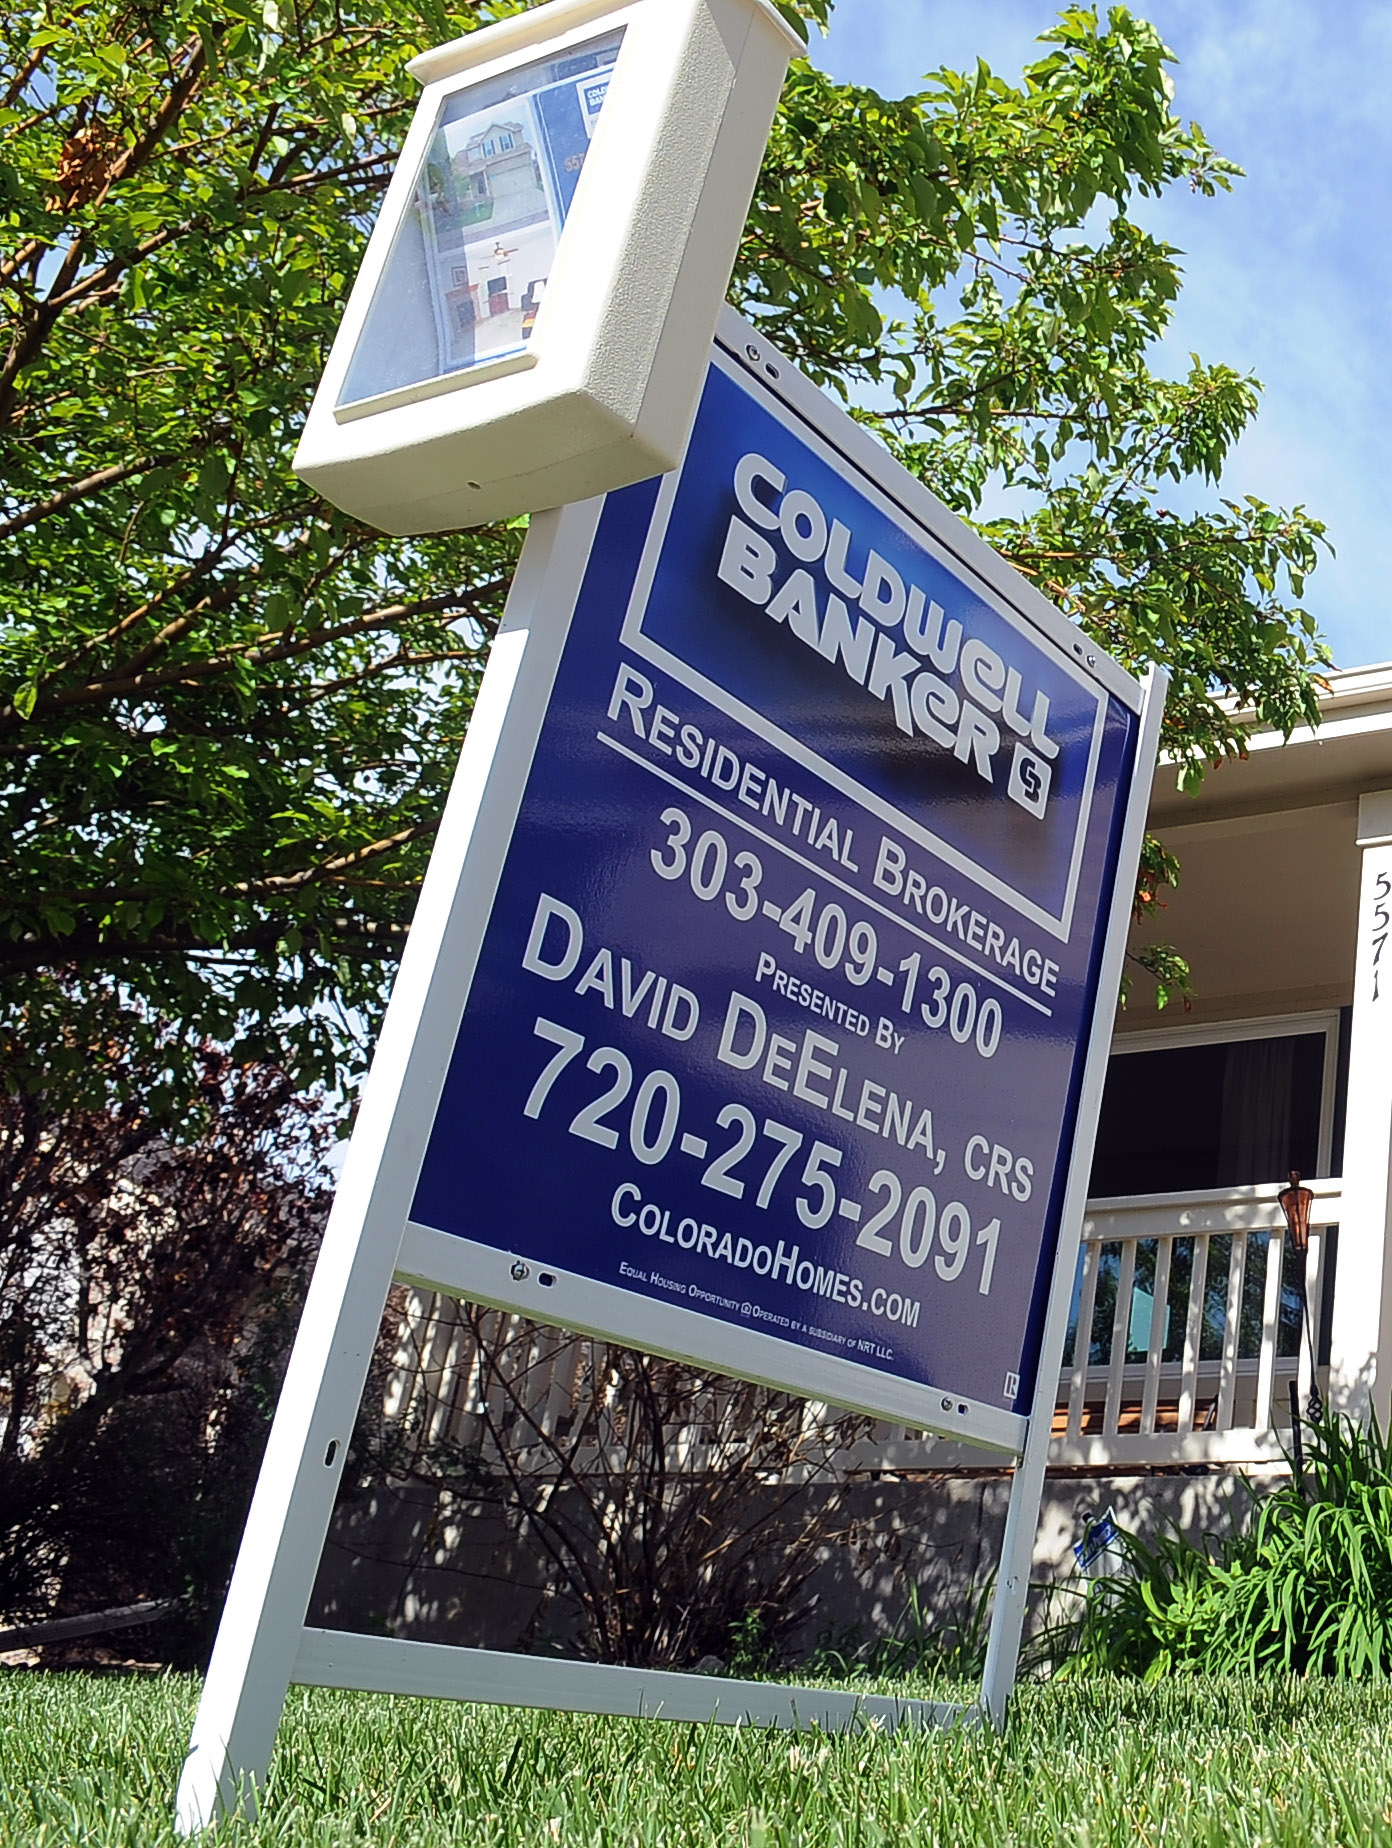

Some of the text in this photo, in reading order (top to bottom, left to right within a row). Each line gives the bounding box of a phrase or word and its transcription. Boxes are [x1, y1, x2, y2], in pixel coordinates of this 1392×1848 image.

[717, 515, 1000, 783] BANKER
[734, 453, 1060, 759] COLDWELL
[607, 662, 1060, 997] RESIDENTIAL BROKERAGE
[650, 807, 1003, 1058] 303-409-1300
[1371, 871, 1392, 1003] 5571
[521, 893, 700, 1042] DAVID
[964, 1135, 1034, 1202] CRS
[755, 952, 905, 1055] PRESENTED BY
[523, 1017, 1002, 1295] 720-275-2091
[611, 1182, 921, 1328] COLORADOHOMES.COM
[619, 1261, 648, 1282] EQUAL
[650, 1271, 686, 1294] HOUSING
[688, 1284, 740, 1311] OPPORTUNITY
[752, 1305, 789, 1328] OPERATED
[791, 1320, 801, 1330] BY
[802, 1324, 807, 1333] A
[809, 1327, 846, 1345] SUBSIDIARY
[847, 1338, 856, 1348] OF
[857, 1339, 876, 1354] NRT
